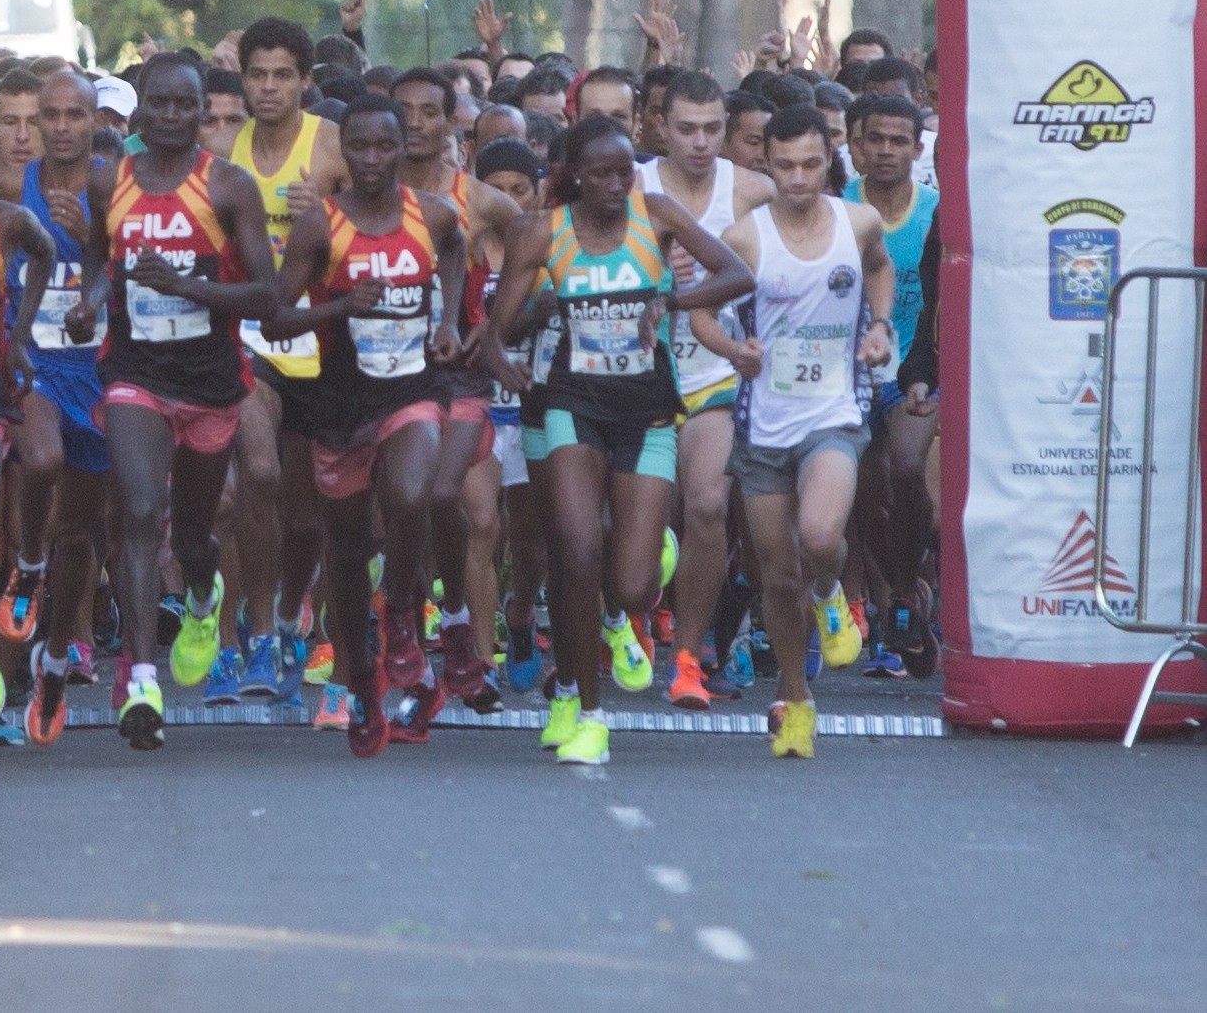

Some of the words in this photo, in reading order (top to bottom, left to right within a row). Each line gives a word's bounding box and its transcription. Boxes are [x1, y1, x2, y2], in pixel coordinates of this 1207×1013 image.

[1041, 124, 1084, 142] FM
[1089, 124, 1130, 142] 97.1
[123, 211, 193, 239] FILA
[348, 248, 420, 280] FILA
[567, 261, 643, 293] FILA
[167, 318, 177, 337] 1
[674, 342, 698, 360] 27
[602, 355, 630, 372] 19
[795, 364, 823, 383] 28
[1039, 447, 1133, 460] UNIVERSIADE
[1012, 464, 1076, 476] ESTADUAL
[1080, 465, 1099, 476] DE
